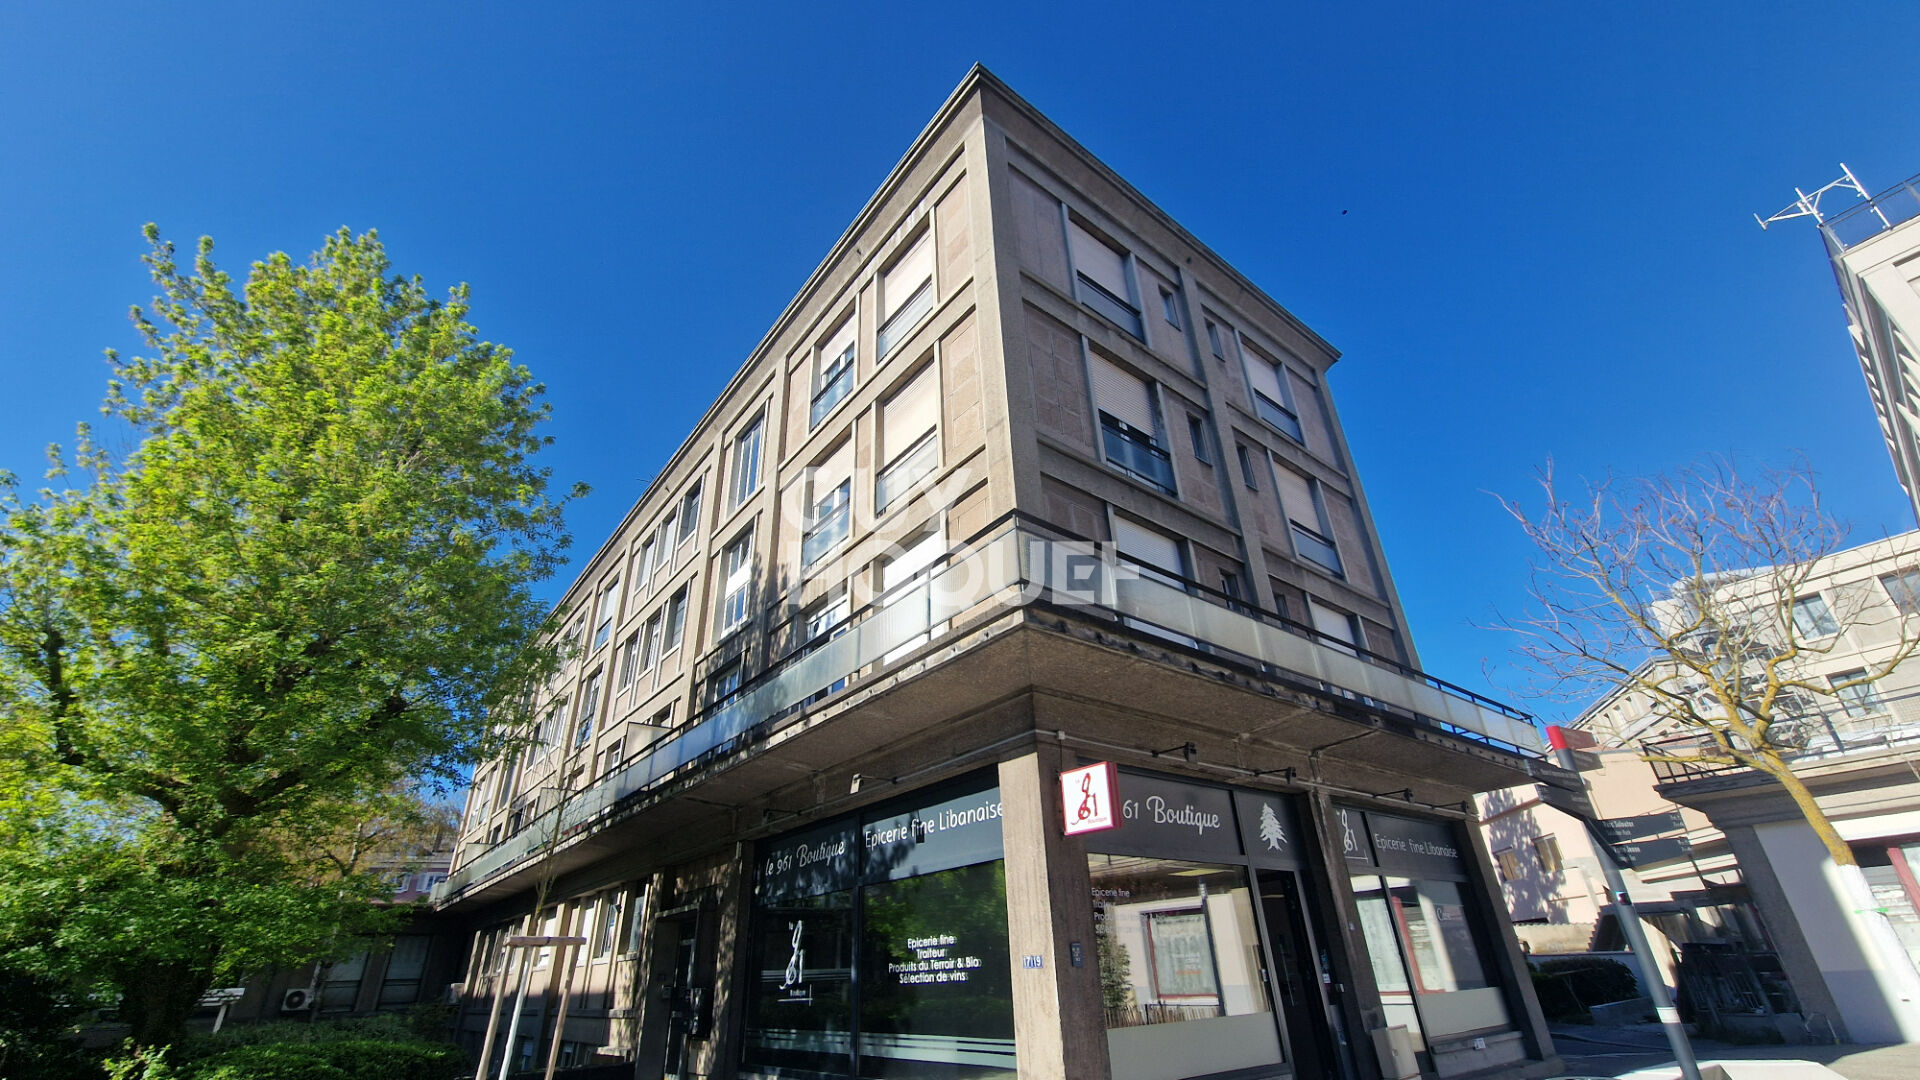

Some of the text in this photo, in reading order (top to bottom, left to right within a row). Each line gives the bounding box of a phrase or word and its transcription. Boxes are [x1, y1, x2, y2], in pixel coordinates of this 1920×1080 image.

[865, 800, 1003, 851] Epicerie fine Libanaise
[1146, 795, 1221, 835] Boutique
[1374, 832, 1459, 858] Epicerie fine Libanaise
[765, 840, 845, 877] le 961 Boutique
[907, 934, 956, 950] Epicerie fine
[915, 948, 946, 959] Traiteur
[888, 956, 980, 973] Produits du Terroir & Bio
[899, 969, 966, 984] Sélection de vins
